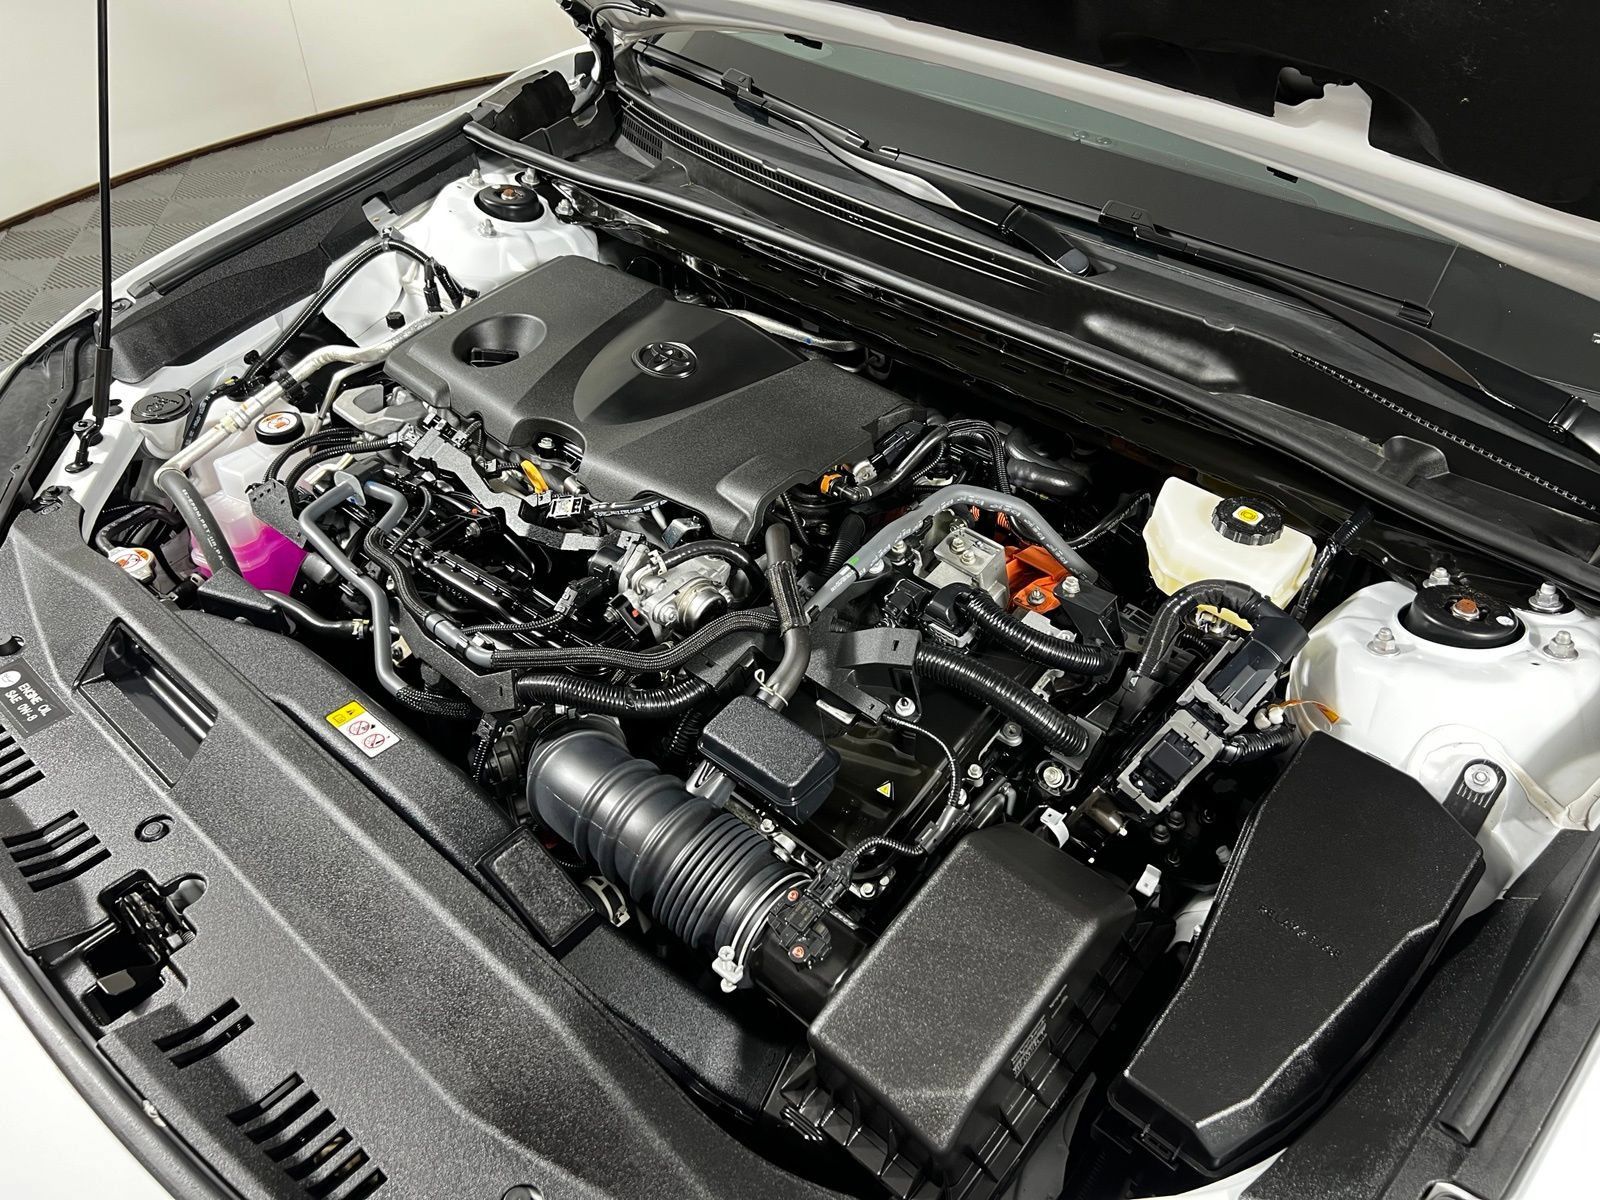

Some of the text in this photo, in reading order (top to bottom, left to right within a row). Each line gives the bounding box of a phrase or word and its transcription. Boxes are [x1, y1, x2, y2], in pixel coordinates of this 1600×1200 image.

[4, 690, 38, 722] SAE 0W-8
[18, 683, 52, 717] ENGINE OIL
